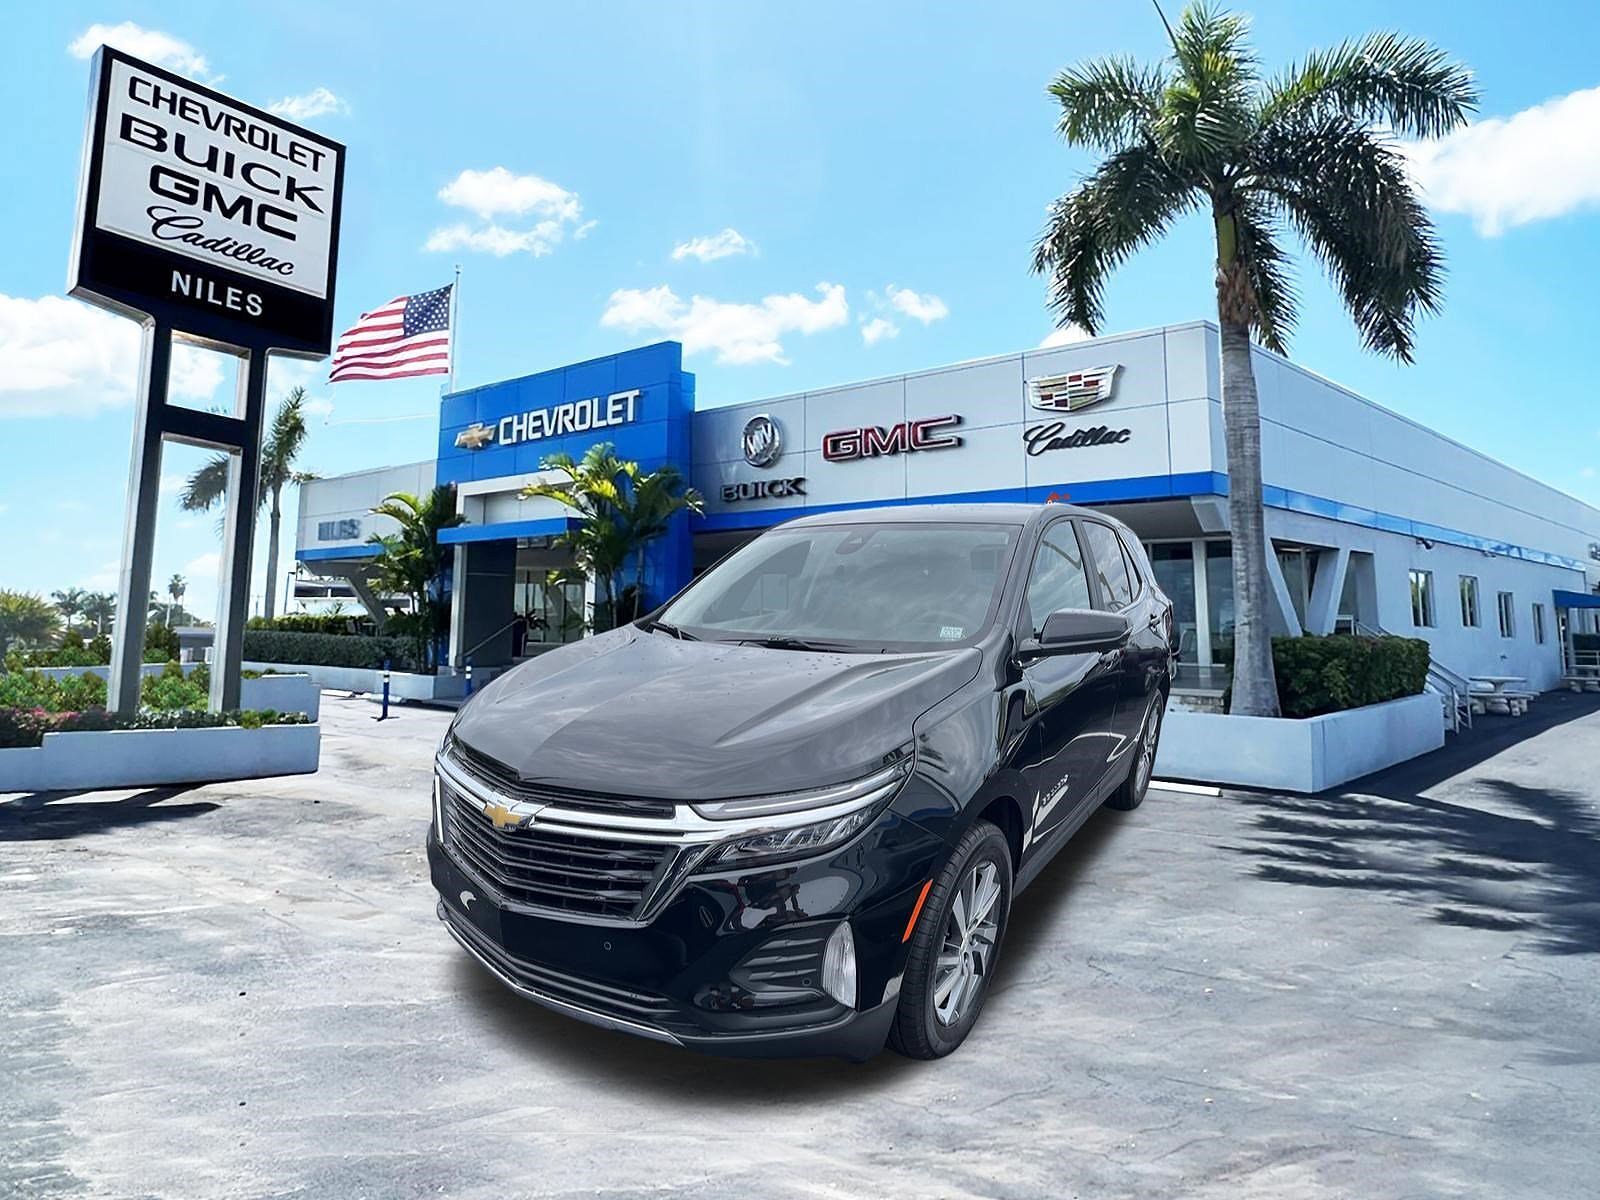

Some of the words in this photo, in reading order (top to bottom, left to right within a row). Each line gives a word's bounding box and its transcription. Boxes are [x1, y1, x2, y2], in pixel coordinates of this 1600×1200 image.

[128, 76, 326, 172] CHEVROLET
[119, 112, 324, 214] BUICK
[149, 164, 298, 241] GMC
[146, 205, 295, 276] Cadillac
[171, 270, 263, 317] NILES
[498, 389, 641, 446] CHEVROLET
[822, 414, 962, 463] GMC
[1023, 422, 1131, 457] Cadillac
[720, 477, 807, 503] BUICK
